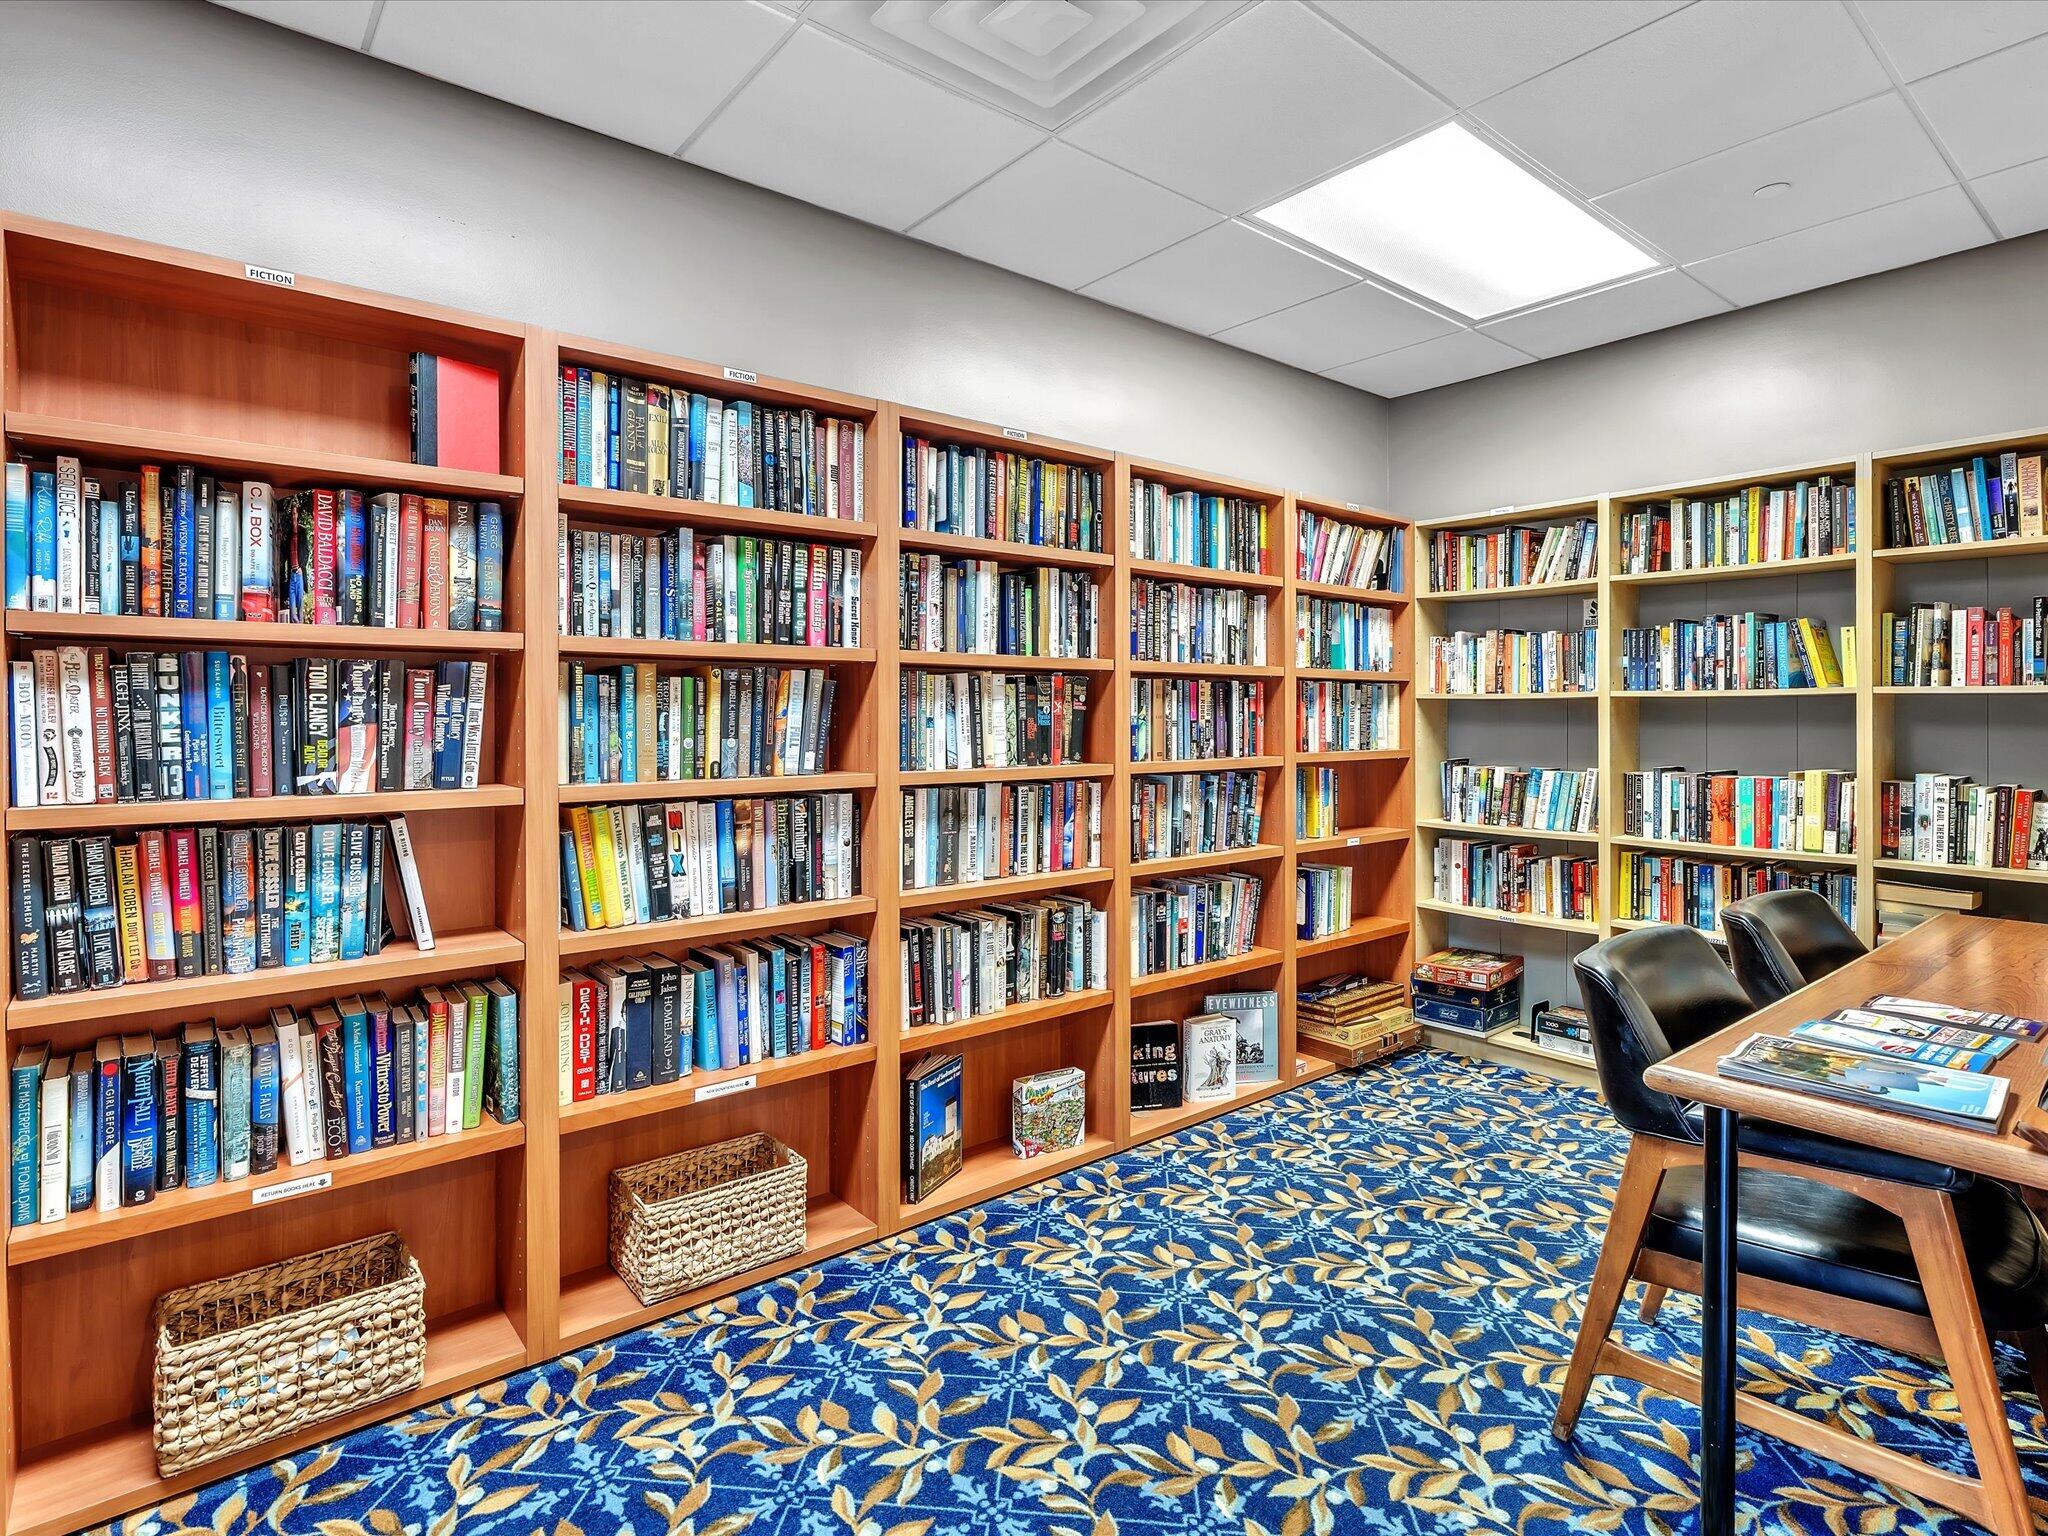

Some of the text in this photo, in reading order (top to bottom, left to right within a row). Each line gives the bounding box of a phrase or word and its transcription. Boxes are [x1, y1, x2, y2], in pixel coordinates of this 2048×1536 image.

[250, 269, 292, 284] FICTION
[729, 370, 755, 381] FICTION
[563, 379, 576, 451] JANET EVANOVICH
[626, 409, 636, 452] GIANTS
[635, 416, 645, 440] FALL
[765, 413, 774, 453] WHIRLWIND
[1007, 430, 1025, 439] FICTION
[677, 430, 685, 486] JONATHAN FRANZEN
[58, 466, 76, 518] SEQUENCE
[125, 491, 135, 512] Under
[1943, 496, 1955, 526] CHRISTY
[250, 516, 262, 547] BOX
[457, 505, 468, 528] DAN
[479, 514, 487, 550] HURWITZ
[490, 517, 498, 549] GREGG
[178, 520, 188, 595] AWESOME CREATION
[317, 494, 333, 591] DAVID BALDACCI
[781, 545, 791, 575] Griffin
[483, 556, 493, 600] NEMESIS
[573, 548, 583, 584] GRAFTON
[588, 549, 597, 581] GRAFTON
[633, 555, 643, 583] Grafton
[667, 554, 676, 587] GRAFTON
[795, 549, 808, 617] Griffin Black
[812, 548, 827, 632] Griffin Hostage
[851, 551, 859, 645] Griffin Secret Honor
[910, 620, 919, 637] Half
[18, 682, 32, 705] BOY
[575, 666, 583, 685] JOHN
[114, 669, 131, 733] HIGH JINX
[308, 665, 328, 738] TOM CLANCY
[408, 676, 430, 738] Tom Clancy
[433, 684, 452, 753] Without Remorse
[446, 697, 466, 741] Tom Clancy
[575, 686, 583, 720] GRISHAM
[641, 671, 654, 746] Alan Greenspan
[20, 714, 33, 749] MOON
[158, 657, 184, 797] BUNKER 13
[213, 707, 226, 769] Bittersweet
[235, 716, 246, 769] Scared Stiff
[96, 720, 111, 778] TURNING BACK
[304, 745, 316, 765] ALIVE
[777, 804, 788, 844] blame
[794, 812, 808, 862] Retribution
[904, 795, 914, 838] ANGEL EYES
[1019, 788, 1028, 867] STEVE MARTINI THE LIST
[119, 848, 138, 919] HARLAN COBEN
[147, 840, 163, 907] MICHAEL CONNELLY
[177, 838, 192, 901] MICHAEL CONNELLY
[232, 833, 249, 912] CLIVE CUSSLER
[264, 832, 280, 909] CLIVE CUSSLER
[294, 831, 306, 893] CLIVE CUSSLER
[321, 830, 335, 905] CLIVE CUSSLER
[349, 830, 363, 898] CLIVE CUSSLER
[614, 829, 632, 912] HIGGINS NIGHT FOX
[22, 860, 33, 928] JEZEBEL REMEDY
[50, 844, 76, 976] HARLAN COBEN STAY CLOSE
[85, 842, 114, 973] HARLAN COBEN LIVE WIRE
[260, 913, 271, 958] CUTTHROAT
[21, 951, 30, 976] CLARK
[30, 947, 40, 977] MARTIN
[660, 973, 677, 984] John
[843, 954, 853, 976] Silva
[856, 949, 868, 978] Silva
[579, 987, 591, 1026] DEATH
[660, 985, 677, 995] Jakes
[684, 977, 694, 999] JOHN
[704, 994, 716, 1020] JANCE
[1208, 995, 1275, 1010] EYEWITNESS
[560, 1001, 570, 1073] JOHN IRVING
[663, 995, 673, 1057] HOMELAND
[775, 1008, 786, 1051] JOHANSEN
[1198, 1033, 1232, 1045] ANATOMY
[1204, 1027, 1227, 1037] GRAY'S
[579, 1033, 591, 1064] DUST
[190, 1057, 200, 1090] DEAVER
[199, 1055, 209, 1089] JEFFERY
[259, 1056, 272, 1120] VIRTUE FALLS
[376, 1053, 392, 1133] Witness Power
[105, 1088, 115, 1145] GIRL BEFORE
[198, 1100, 207, 1170] THE BURIAL HOUR
[327, 1117, 341, 1147] ECO
[17, 1072, 31, 1222] THE FIONA DAVIS
[142, 1135, 153, 1169] NELSON
[260, 1181, 316, 1198] RETURN BOOKS HERE
